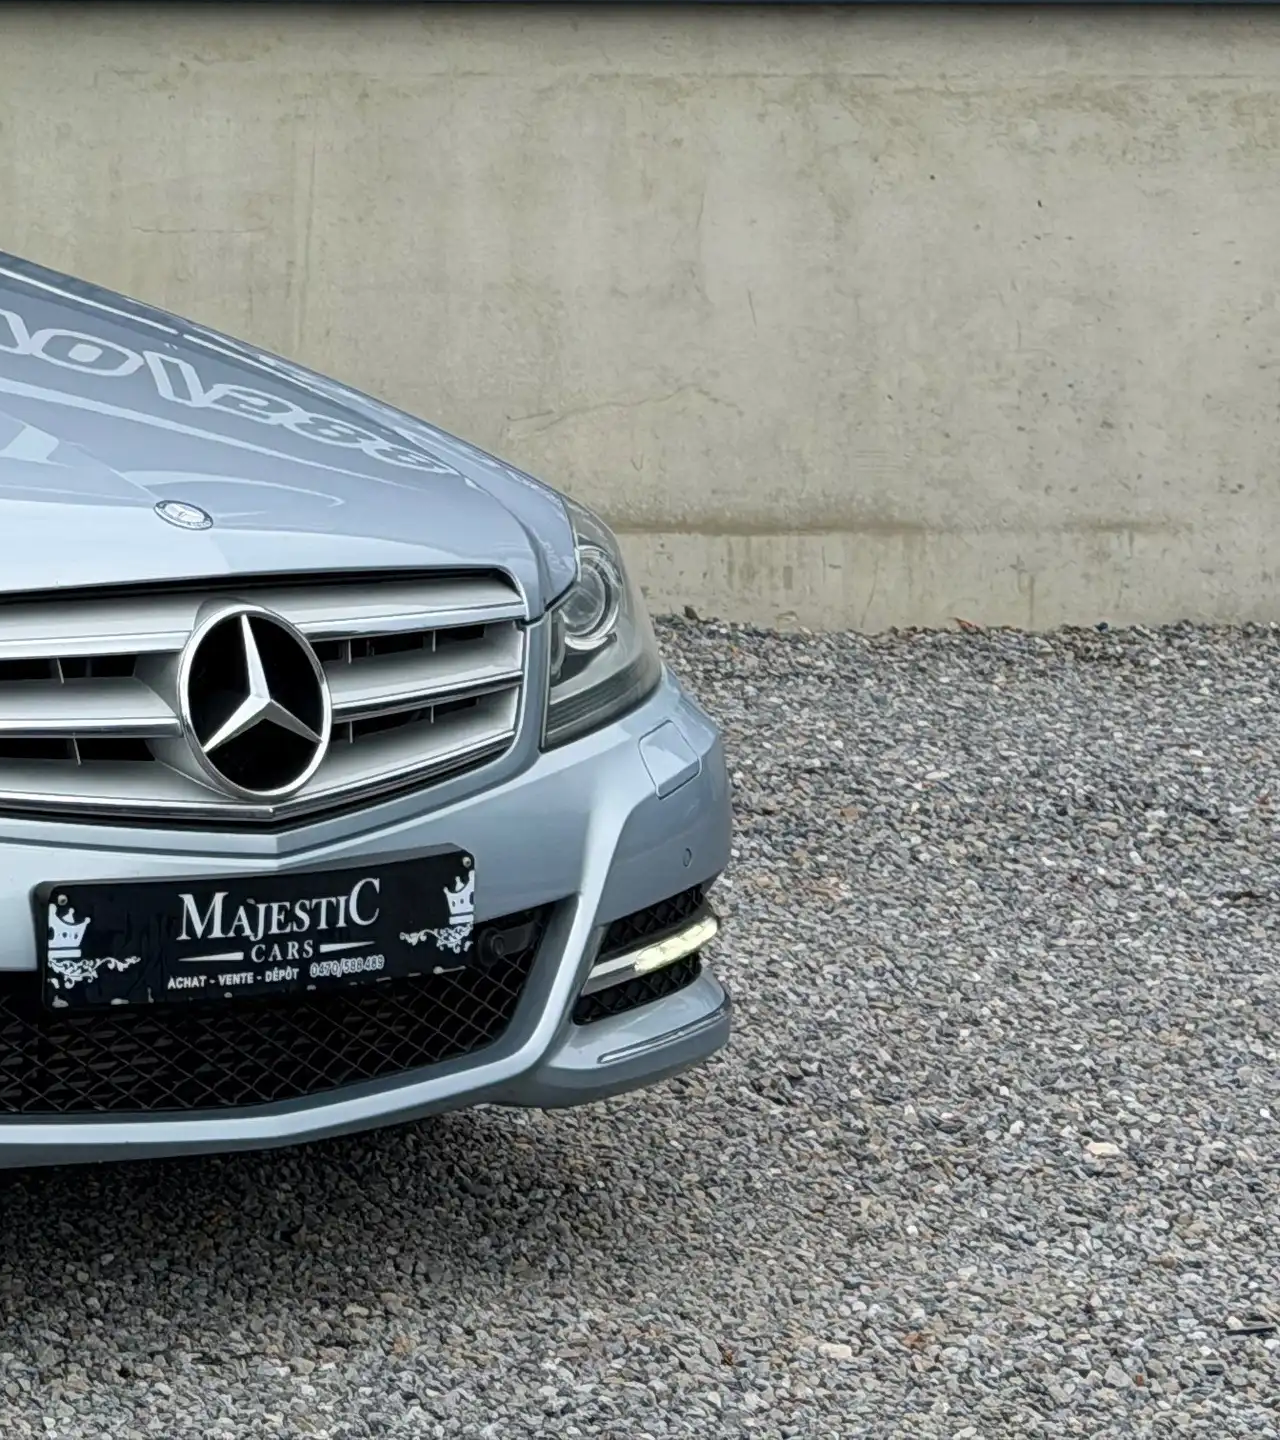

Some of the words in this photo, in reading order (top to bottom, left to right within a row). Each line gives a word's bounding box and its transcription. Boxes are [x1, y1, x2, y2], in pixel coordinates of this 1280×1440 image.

[176, 878, 381, 942] MAJESTIC
[251, 940, 315, 963] CARS
[168, 975, 207, 990] ACHAT
[218, 971, 255, 986] VENTE
[265, 965, 300, 982] DÉPÔT
